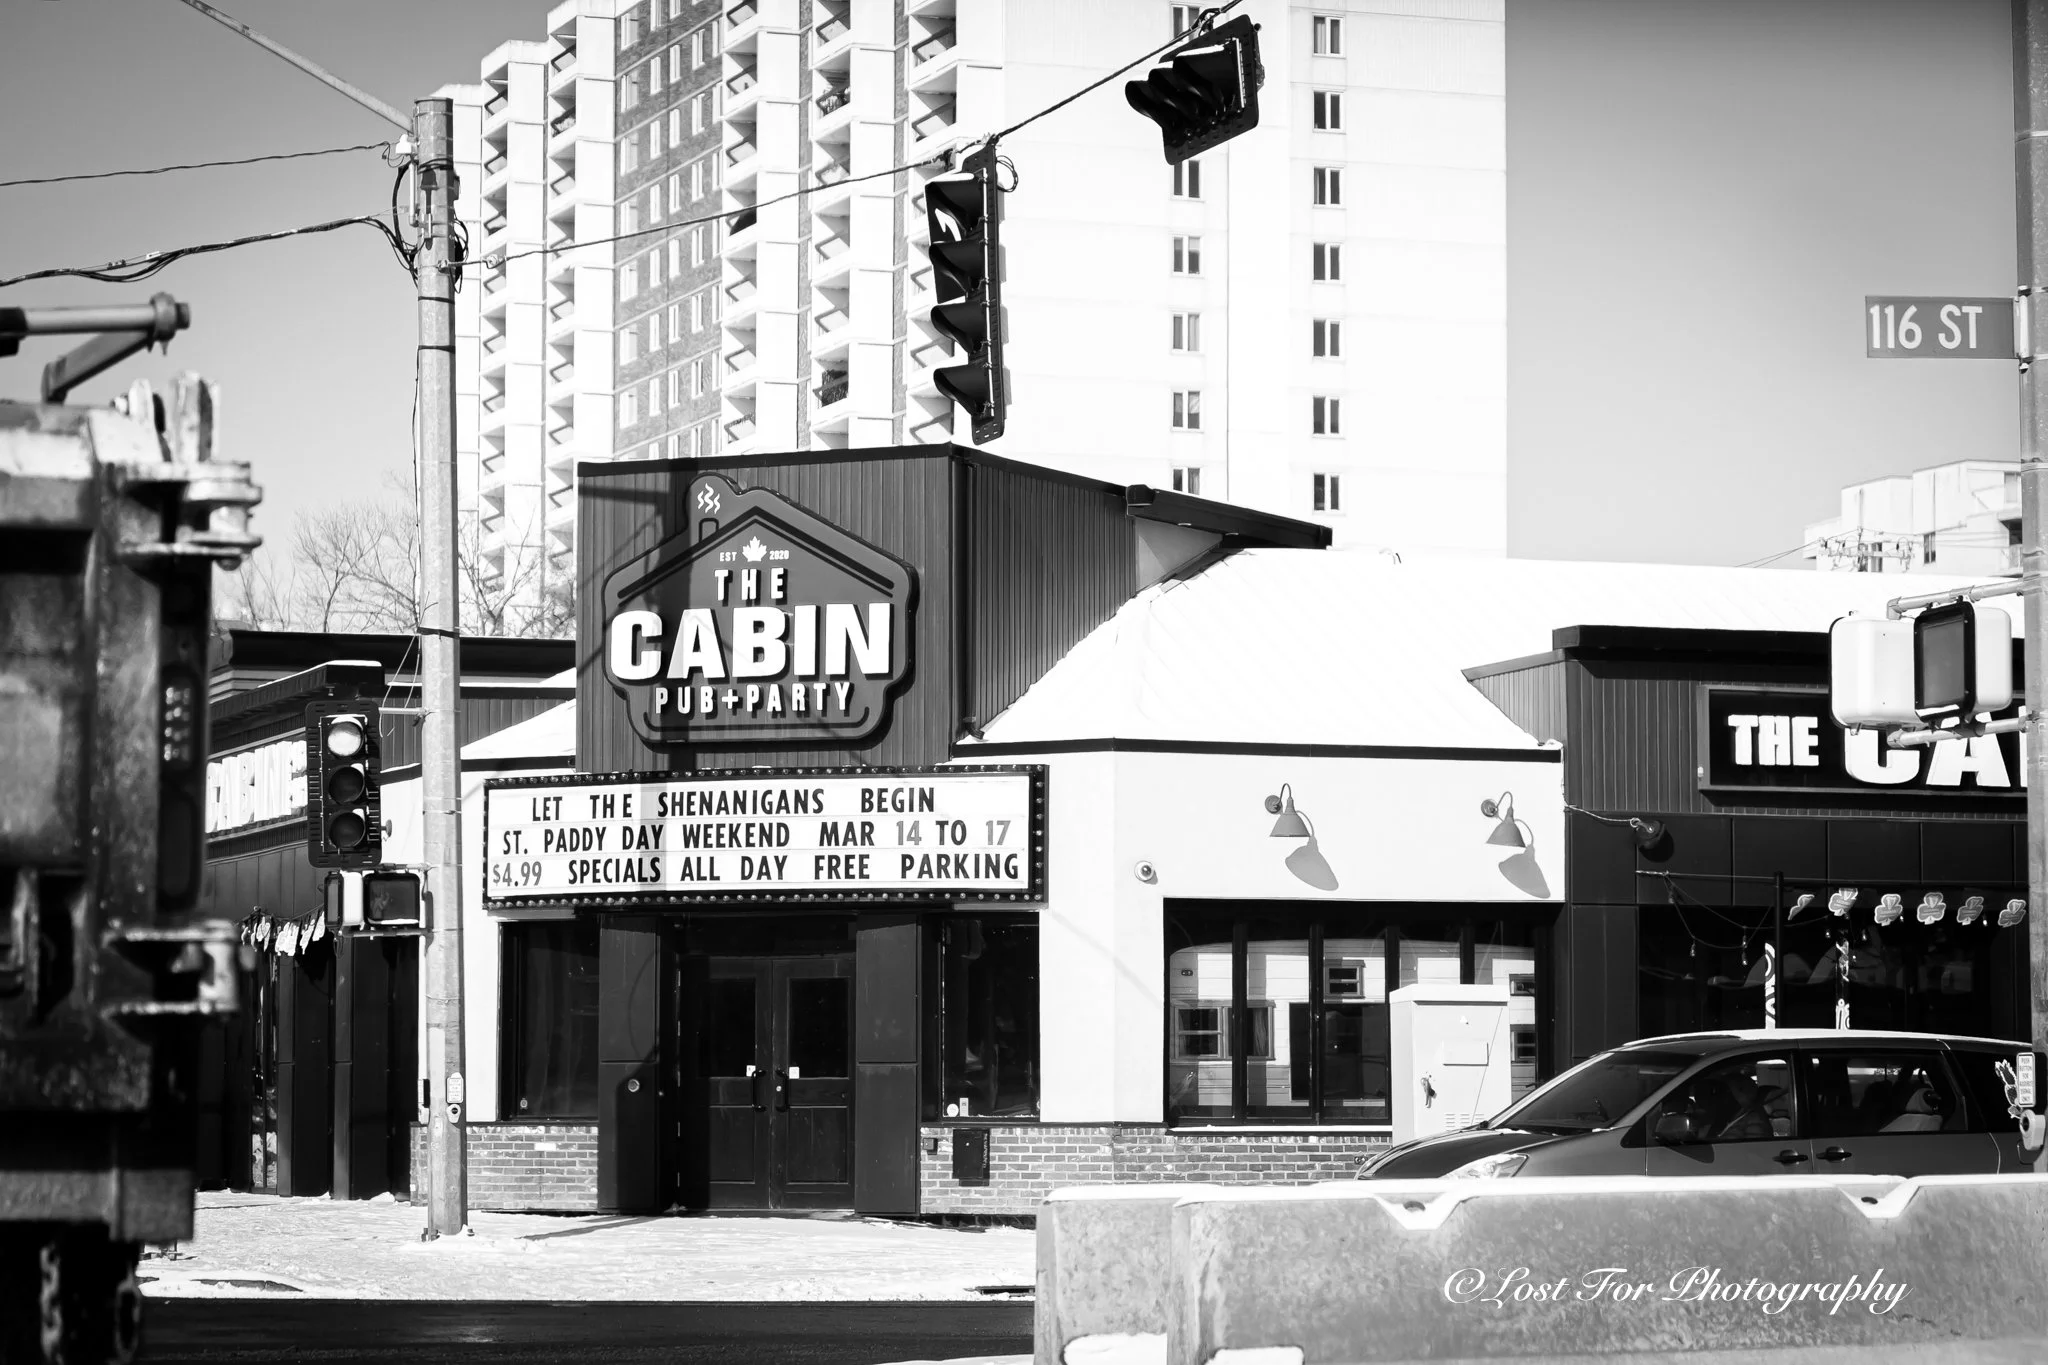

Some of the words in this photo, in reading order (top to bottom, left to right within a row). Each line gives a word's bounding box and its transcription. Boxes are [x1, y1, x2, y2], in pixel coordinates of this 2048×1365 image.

[1869, 304, 1922, 350] 116
[1938, 304, 1983, 350] ST
[720, 552, 737, 561] EST
[769, 550, 790, 560] 2020
[714, 567, 785, 601] THE
[610, 602, 891, 681] CABIN
[655, 682, 851, 714] PUB+PARTY
[1727, 714, 1820, 766] THE
[532, 796, 563, 821] LET
[590, 793, 633, 819] THE
[657, 788, 825, 818] SHENANIGANS
[861, 786, 935, 813] BEGIN
[503, 830, 528, 855] ST.
[544, 827, 607, 853] PADDY
[622, 824, 664, 850] DAY
[682, 822, 790, 849] WEEKEND
[819, 820, 875, 847] MAR
[896, 820, 922, 846] 14
[935, 819, 967, 846] TO
[985, 819, 1011, 846] 17
[492, 861, 542, 887] $4.99
[568, 856, 661, 884] SPECIALS
[680, 856, 720, 882] ALL
[740, 854, 788, 881] DAY
[814, 854, 871, 880] FREE
[900, 853, 1019, 880] PARKING
